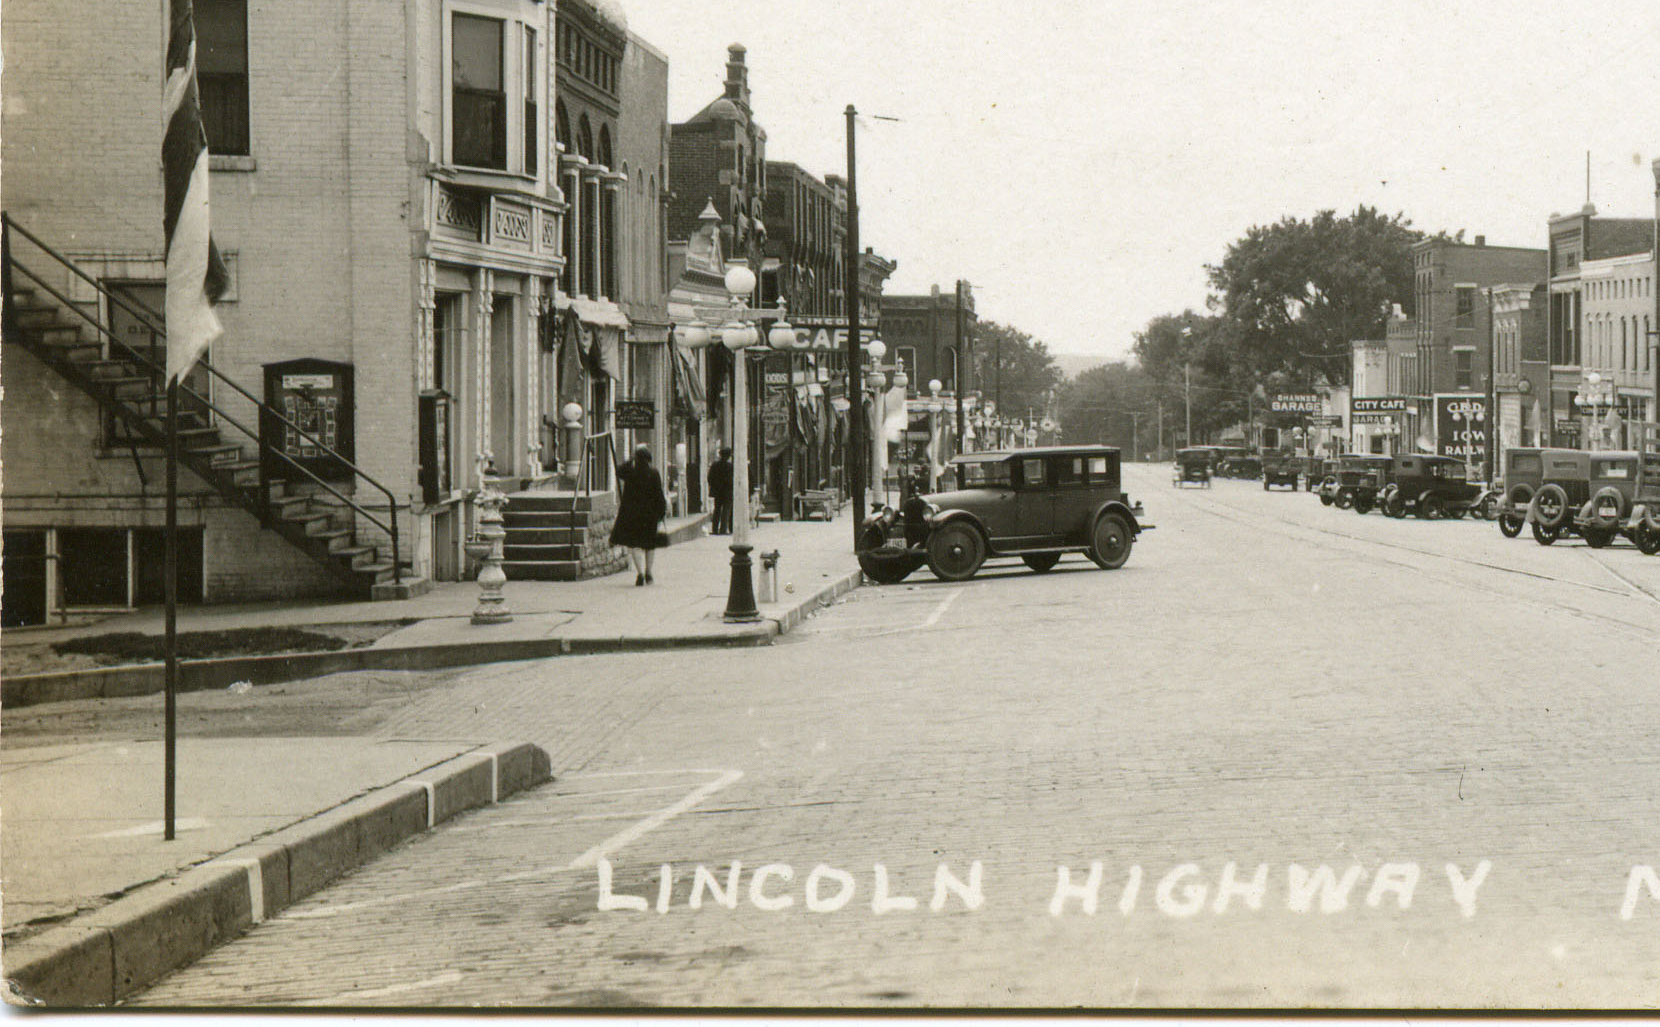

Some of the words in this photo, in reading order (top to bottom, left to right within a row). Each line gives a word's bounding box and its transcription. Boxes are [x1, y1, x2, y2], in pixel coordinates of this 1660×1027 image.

[797, 317, 868, 326] LINCON
[791, 328, 875, 350] CAFE
[1271, 401, 1322, 412] GARAGE
[1354, 400, 1378, 410] CITY
[1380, 400, 1406, 410] CAFE
[1353, 415, 1392, 424] GARAG
[1453, 430, 1486, 442] IOW
[1445, 445, 1486, 455] RAILW
